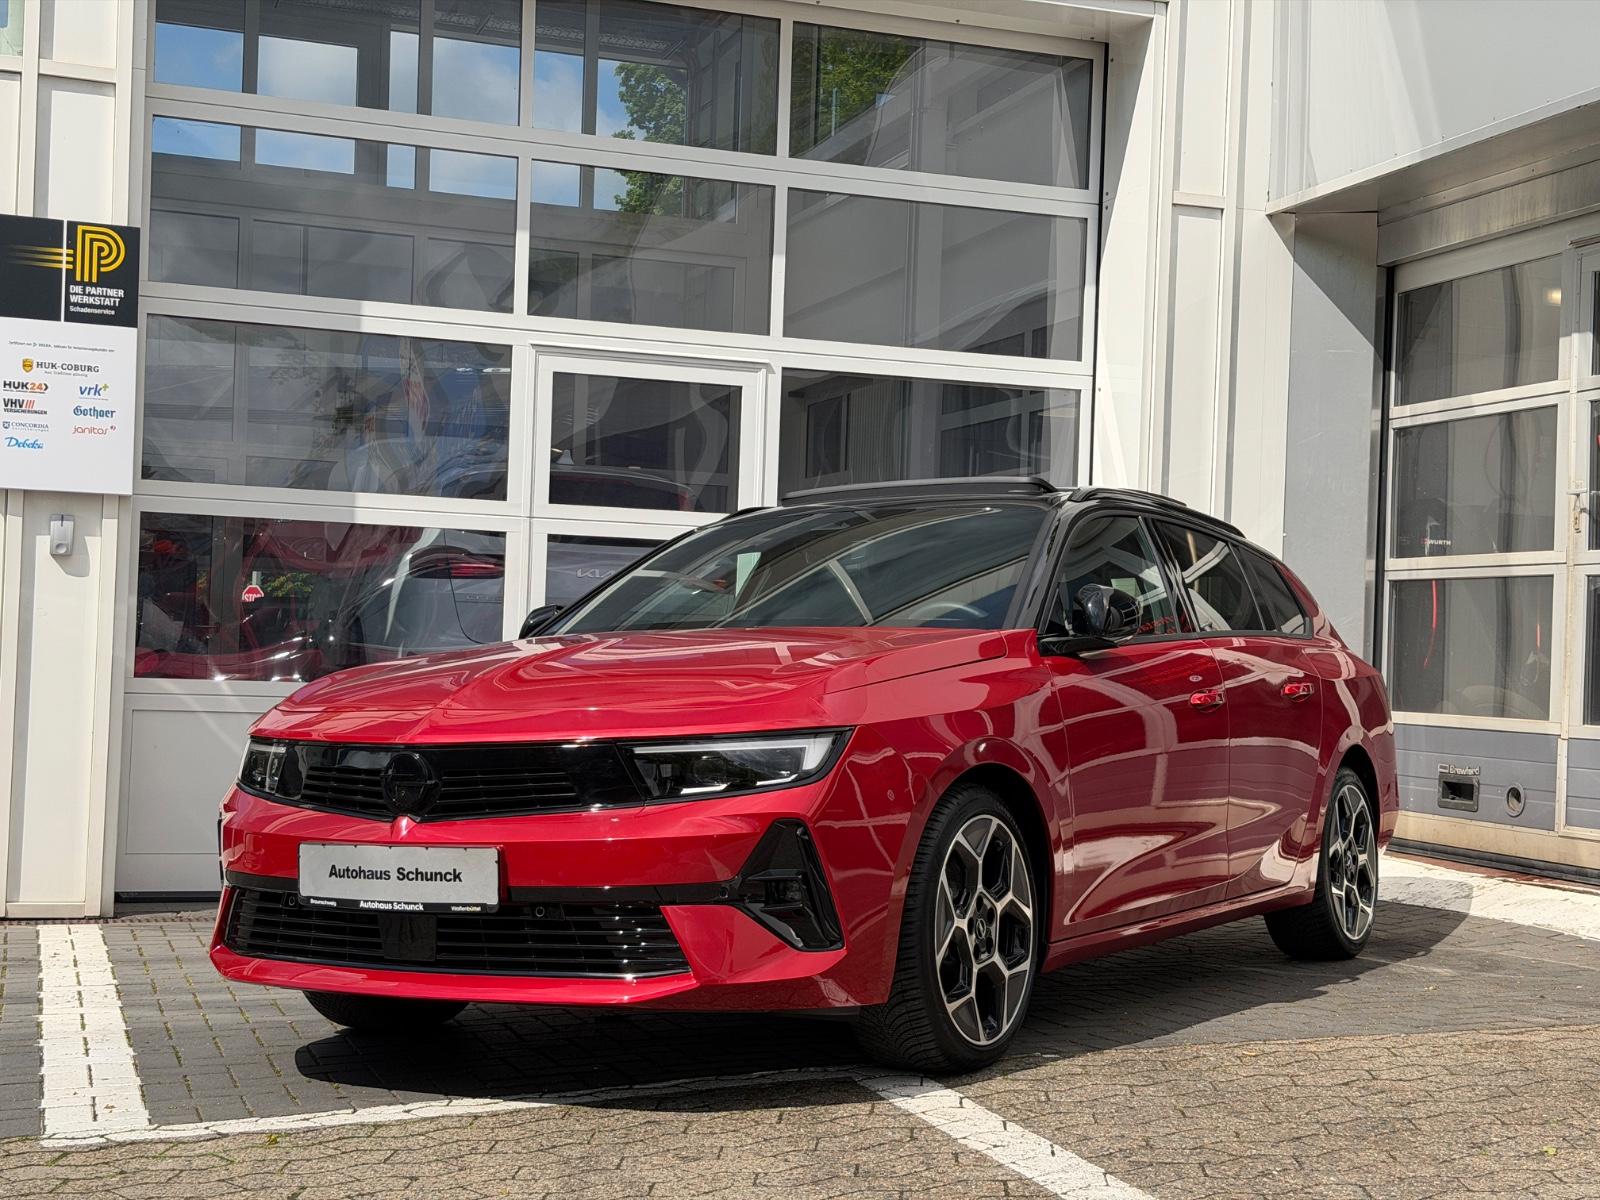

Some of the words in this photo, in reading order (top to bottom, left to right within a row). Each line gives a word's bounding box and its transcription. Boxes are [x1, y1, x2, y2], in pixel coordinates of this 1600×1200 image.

[69, 285, 84, 294] DIE
[86, 286, 125, 298] PARTNER
[69, 294, 120, 307] WERKSTATT
[69, 305, 115, 315] Schadenservice
[36, 360, 100, 373] HUK-COBURG
[73, 405, 116, 419] Gothaer
[11, 421, 49, 429] CONCORDIA
[328, 864, 391, 881] Autohaus
[396, 866, 463, 883] Schunck
[359, 900, 392, 910] Autohaus
[392, 901, 424, 911] Schunck
